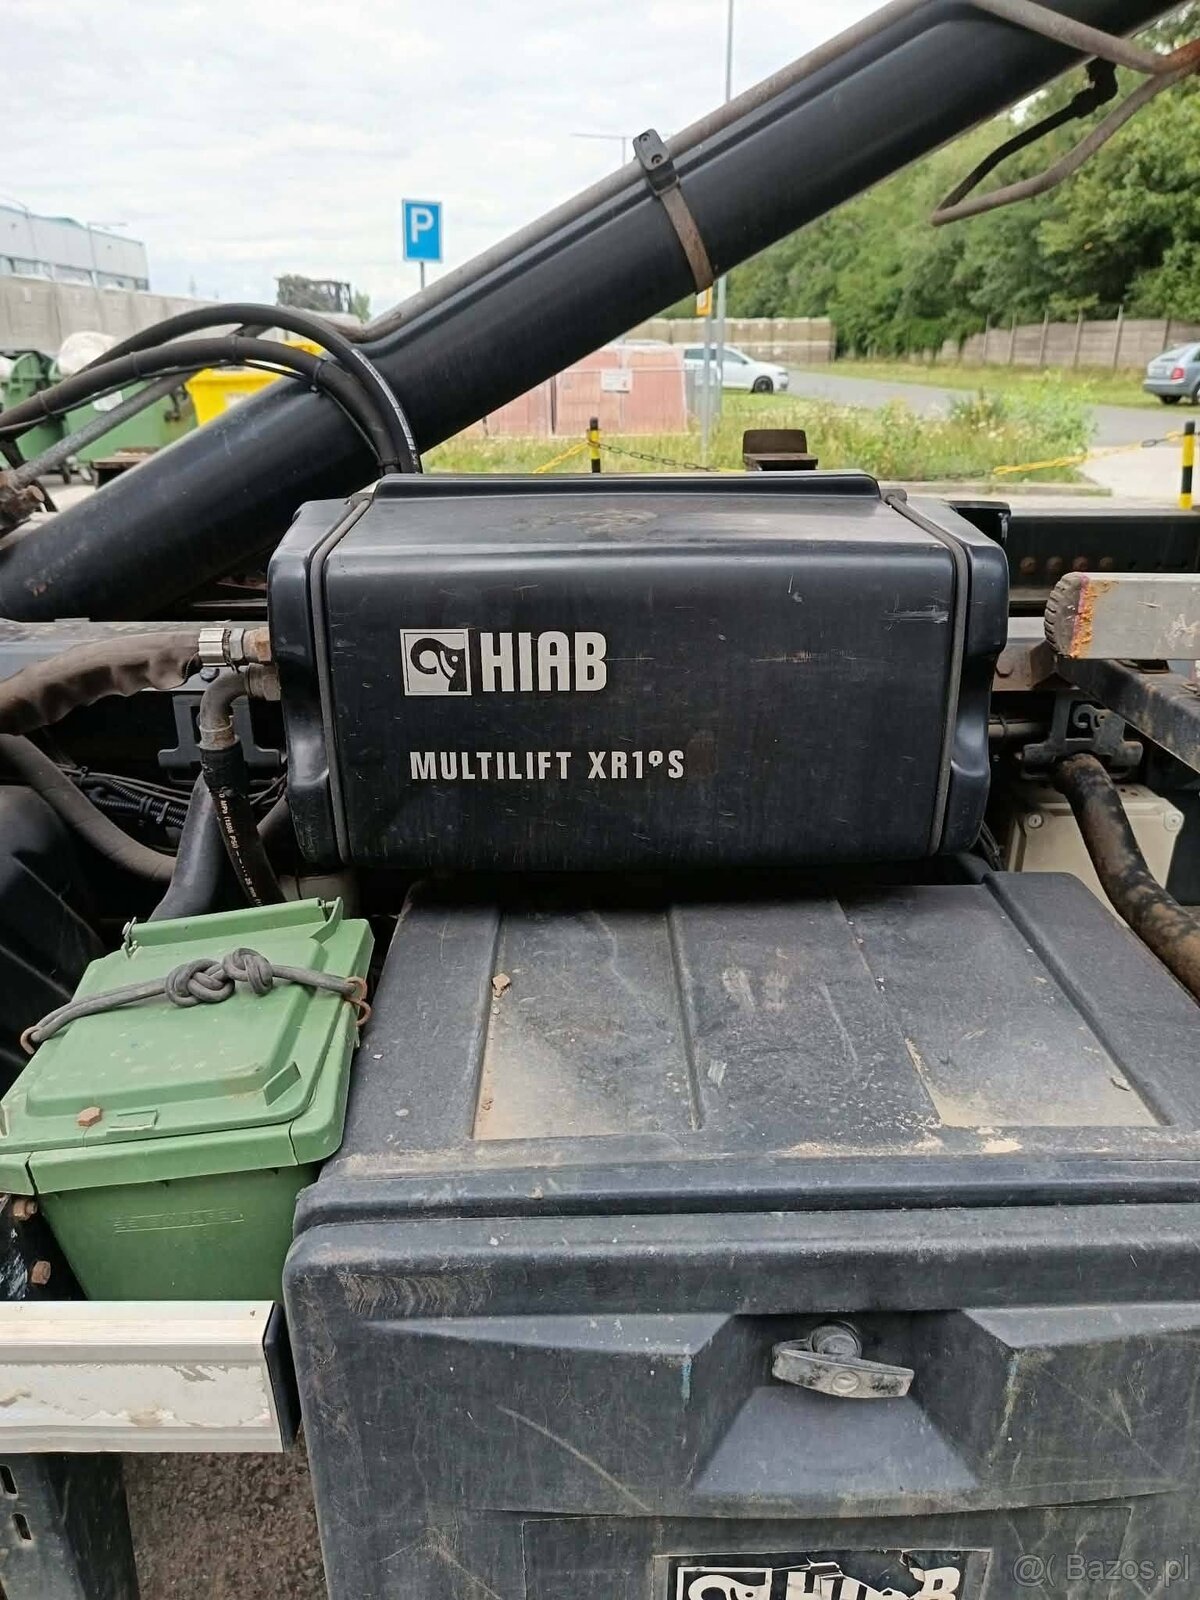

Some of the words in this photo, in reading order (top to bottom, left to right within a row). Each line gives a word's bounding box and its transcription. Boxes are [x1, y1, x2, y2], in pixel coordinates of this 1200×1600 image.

[411, 207, 434, 243] P
[480, 630, 607, 692] HIAB
[409, 751, 571, 780] MULTILIFT
